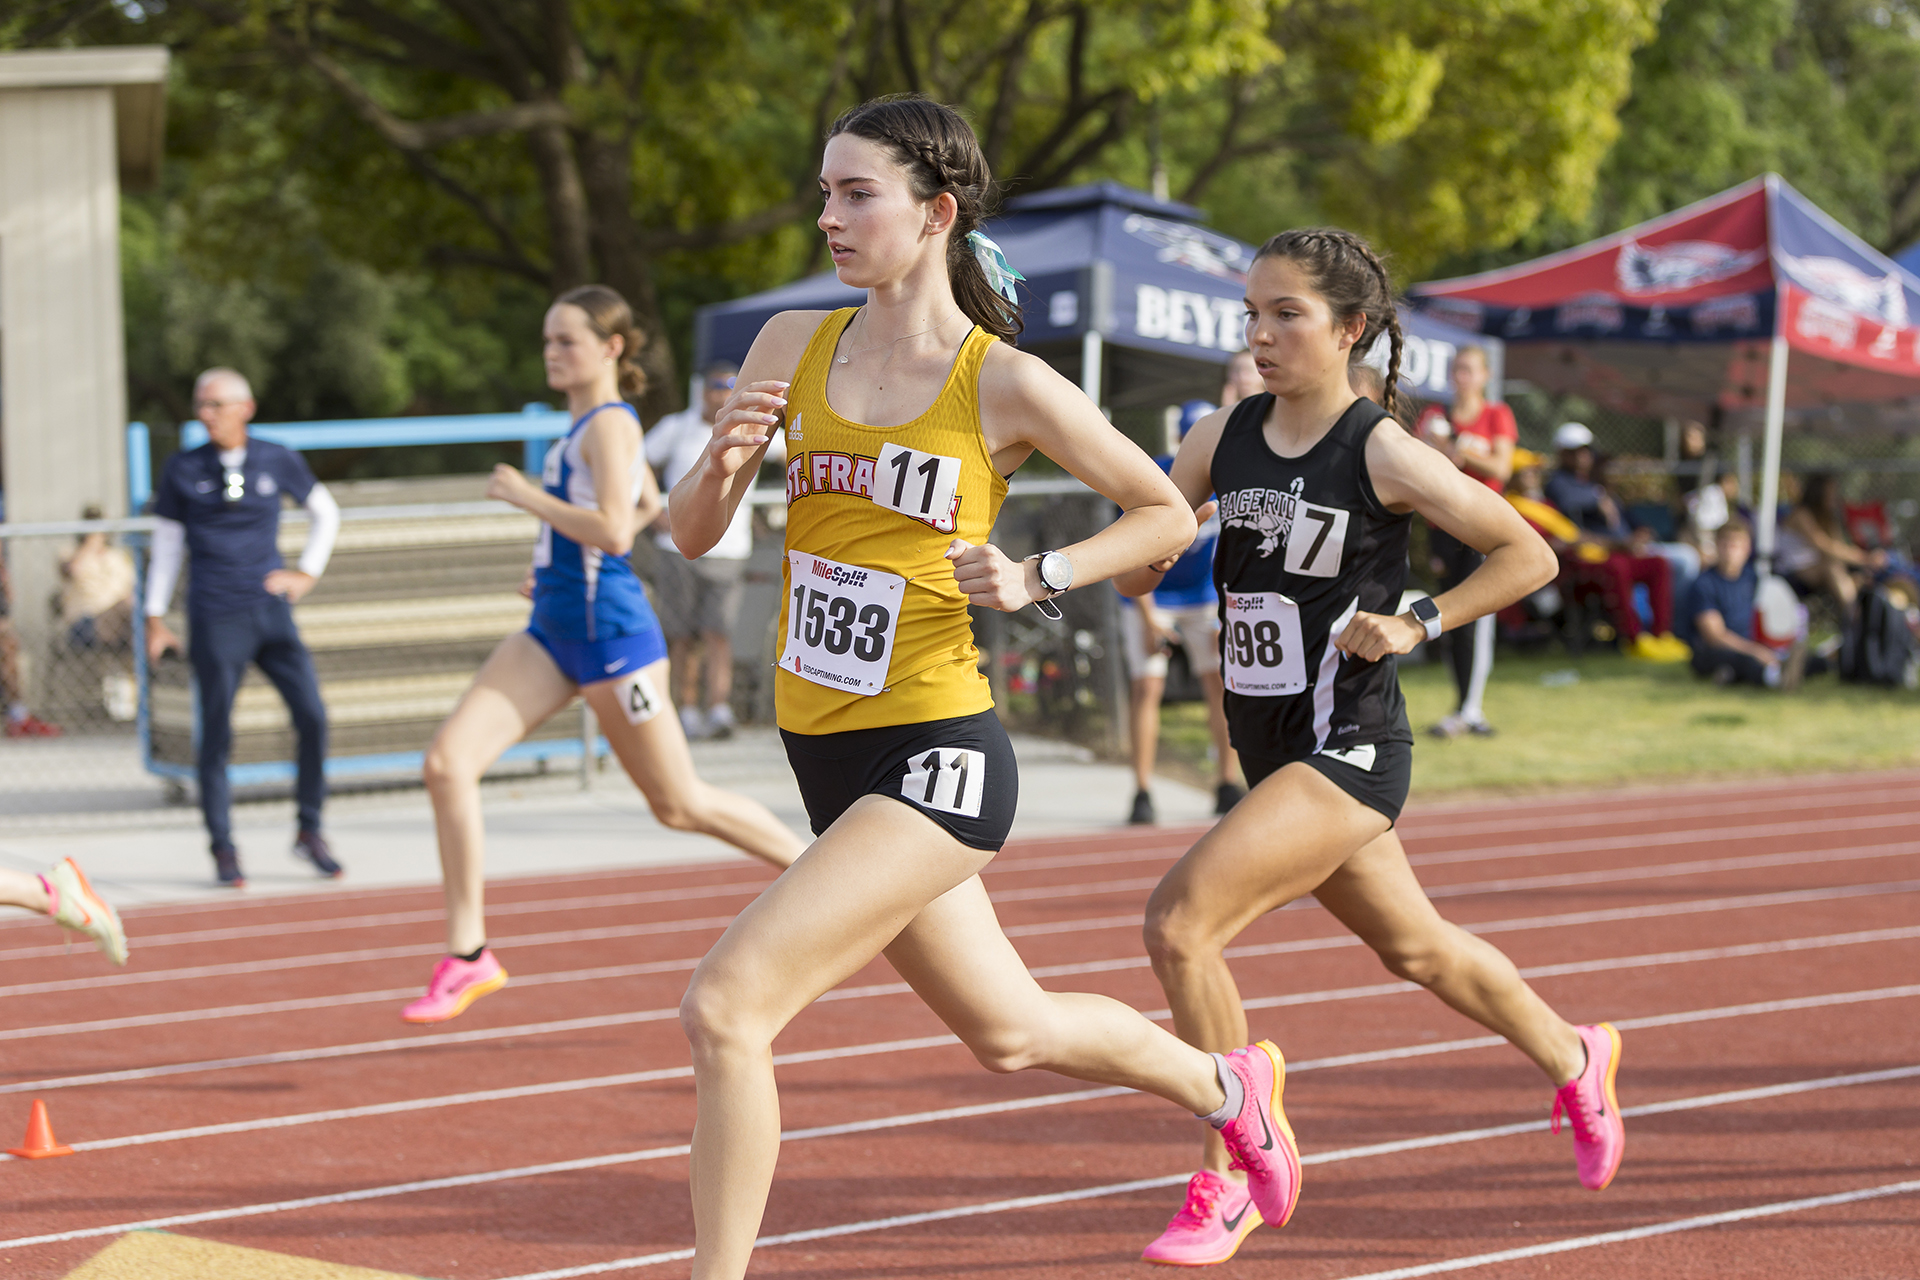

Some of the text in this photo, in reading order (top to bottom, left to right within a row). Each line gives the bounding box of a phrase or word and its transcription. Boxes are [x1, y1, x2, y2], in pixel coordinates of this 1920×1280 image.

[1135, 283, 1247, 354] BEYE
[787, 452, 811, 509] ST.
[890, 450, 940, 515] 11
[1263, 489, 1298, 524] RID
[1299, 508, 1336, 571] 7
[811, 559, 868, 588] MileSplit
[794, 583, 890, 663] 1533
[631, 683, 650, 712] 4
[803, 663, 861, 687] REDCAPTIMING.COM
[921, 750, 969, 809] 11
